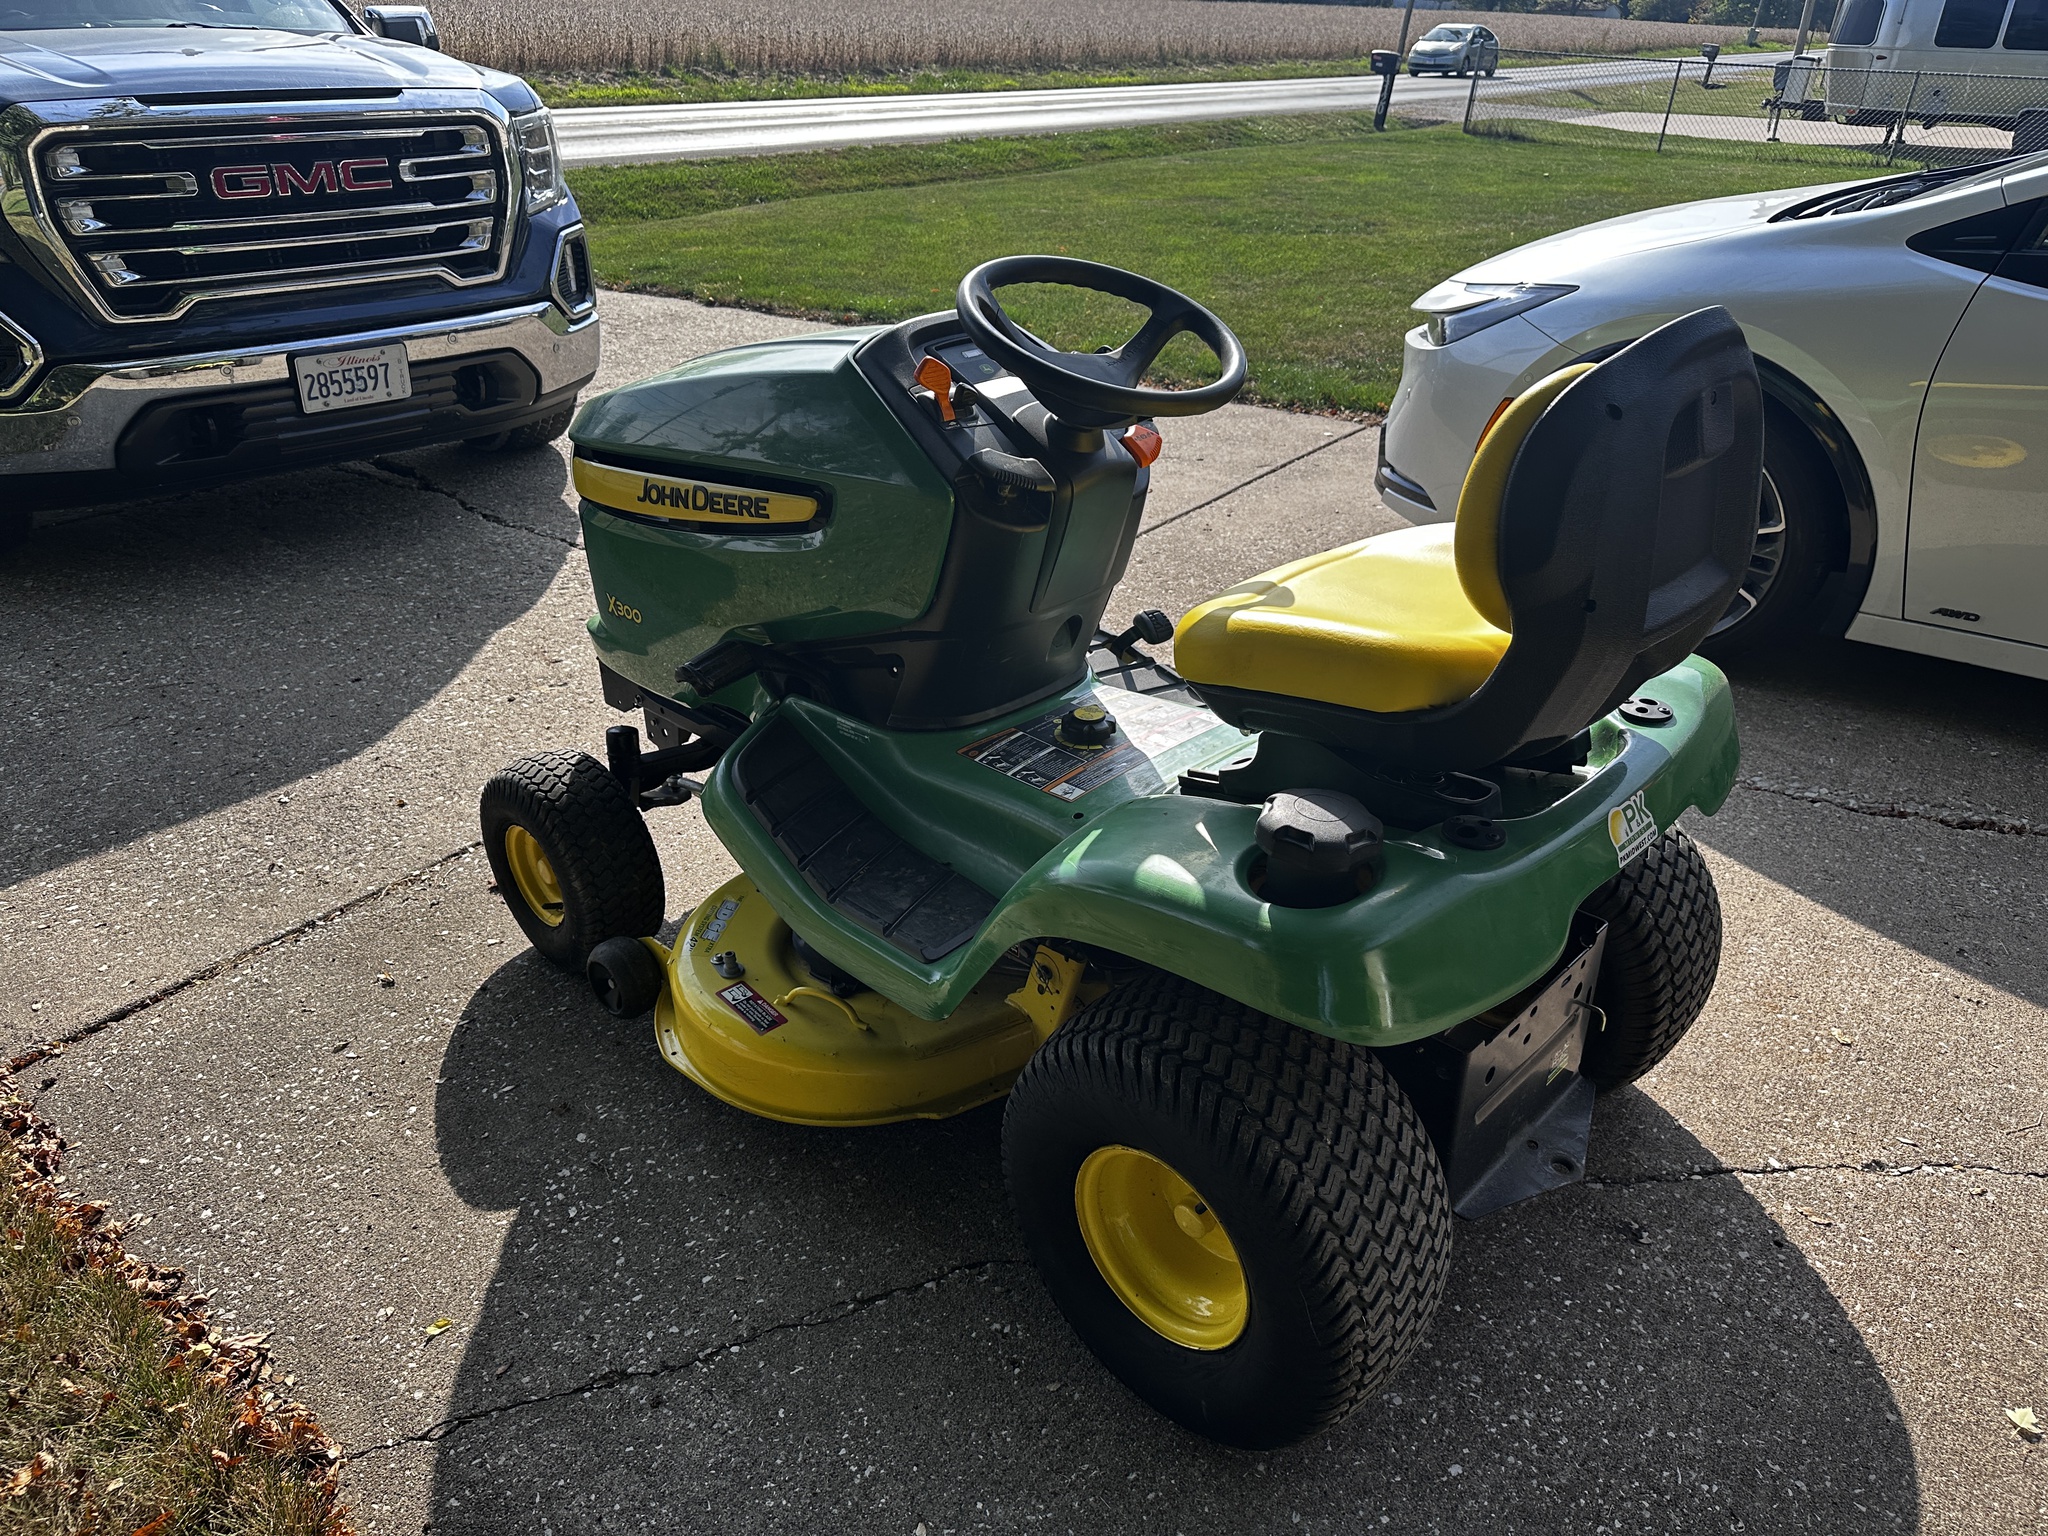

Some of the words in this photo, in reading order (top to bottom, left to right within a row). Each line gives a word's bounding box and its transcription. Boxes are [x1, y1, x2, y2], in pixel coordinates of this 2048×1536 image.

[210, 157, 393, 200] GMC
[324, 354, 381, 368] Illinois
[304, 362, 389, 401] 2855597
[637, 478, 689, 510] JOHN
[691, 484, 770, 519] DEERE
[605, 592, 642, 624] X300
[1929, 607, 1981, 622] AWD
[1620, 828, 1657, 865] PKMIDWEST.COM
[1624, 826, 1648, 847] MIDWEST
[701, 899, 739, 942] EDGE
